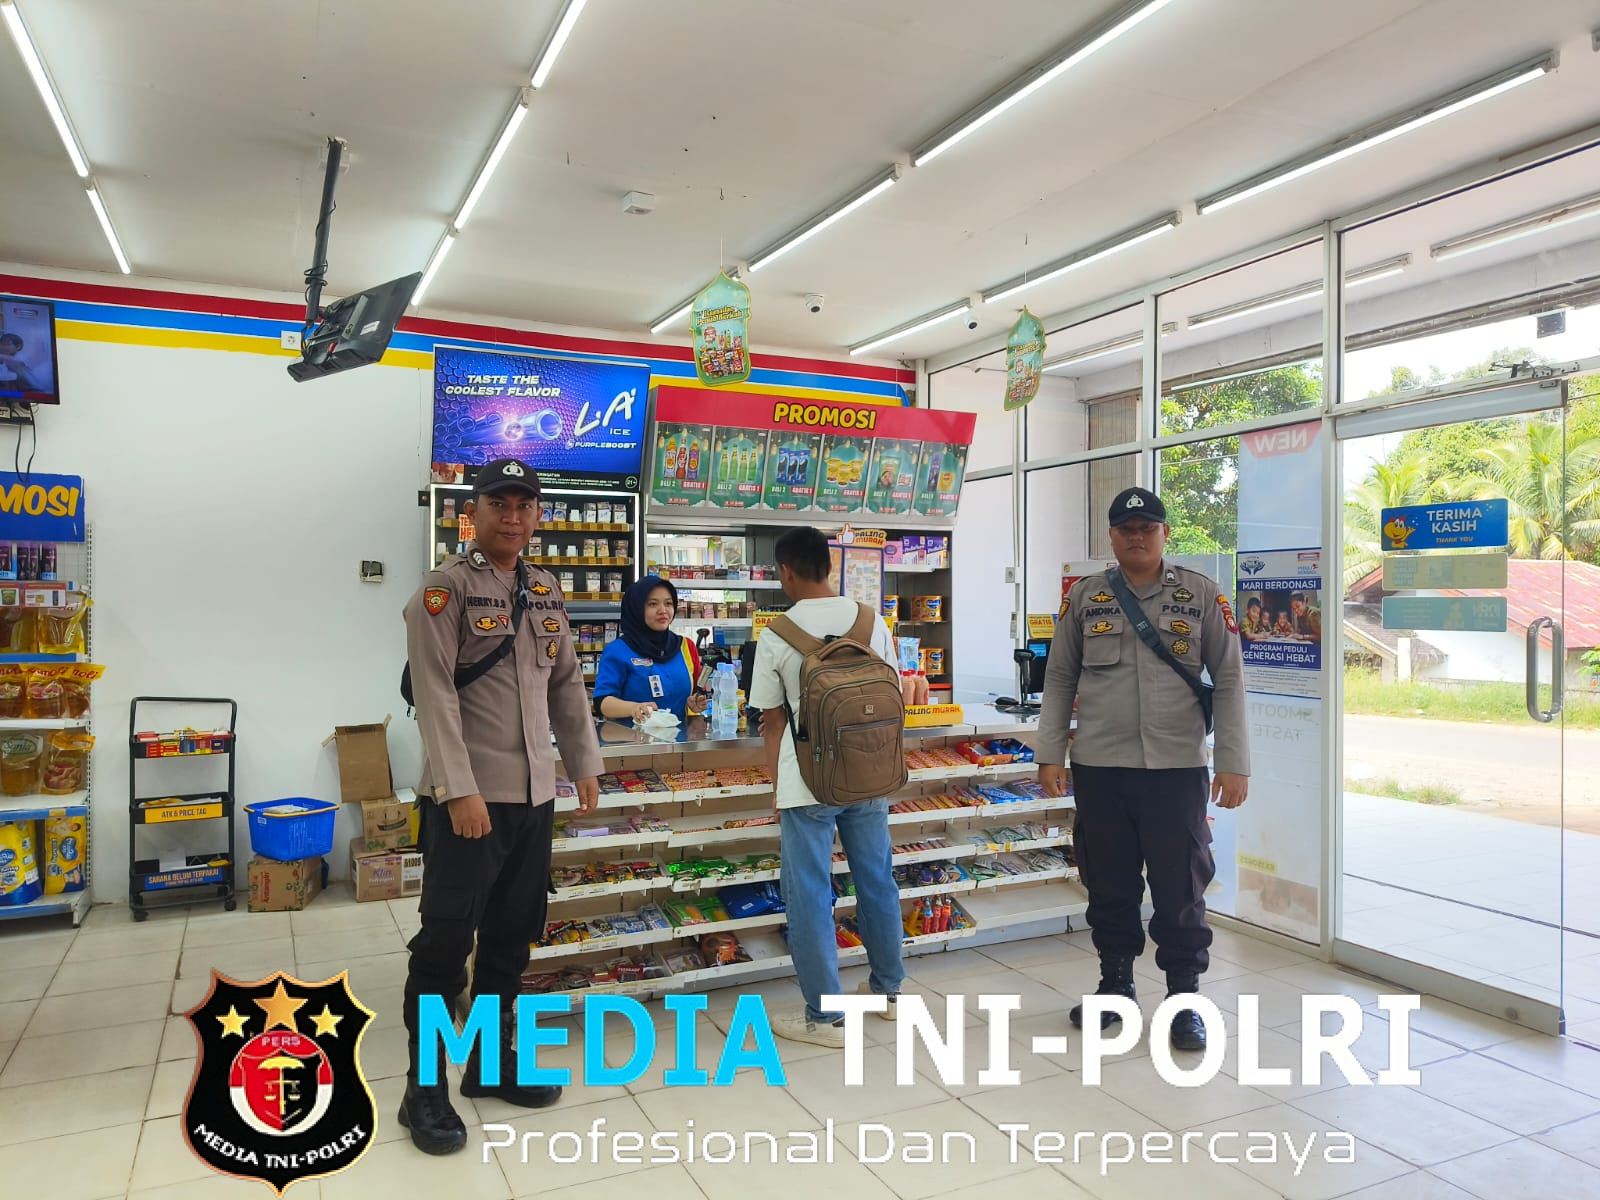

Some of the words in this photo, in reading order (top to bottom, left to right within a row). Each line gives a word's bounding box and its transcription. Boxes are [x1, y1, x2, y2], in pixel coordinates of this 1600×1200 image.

[467, 374, 507, 385] TASTE
[512, 375, 540, 385] THE
[445, 385, 503, 396] COOLEST
[507, 387, 561, 397] FLAVOR
[773, 402, 877, 430] PROMOSI
[610, 428, 632, 436] ICE
[574, 441, 637, 449] PURPLEBOOST
[1426, 507, 1482, 522] TERIMA
[1431, 520, 1477, 534] KASIH
[1242, 581, 1263, 591] MARI
[1265, 580, 1316, 590] BERDONASI
[528, 600, 564, 611] POLRI
[1085, 607, 1121, 618] ANDIKA
[1162, 605, 1201, 618] POLRI
[1250, 644, 1282, 652] PROGRAM
[1283, 645, 1308, 653] PEDULI
[1242, 651, 1284, 661] GENERASI
[1286, 654, 1316, 663] HEBAT
[931, 705, 960, 714] MURAH
[179, 808, 194, 817] PRICE
[196, 807, 207, 815] TAG
[148, 874, 172, 884] SARANA
[172, 872, 192, 882] BELUM
